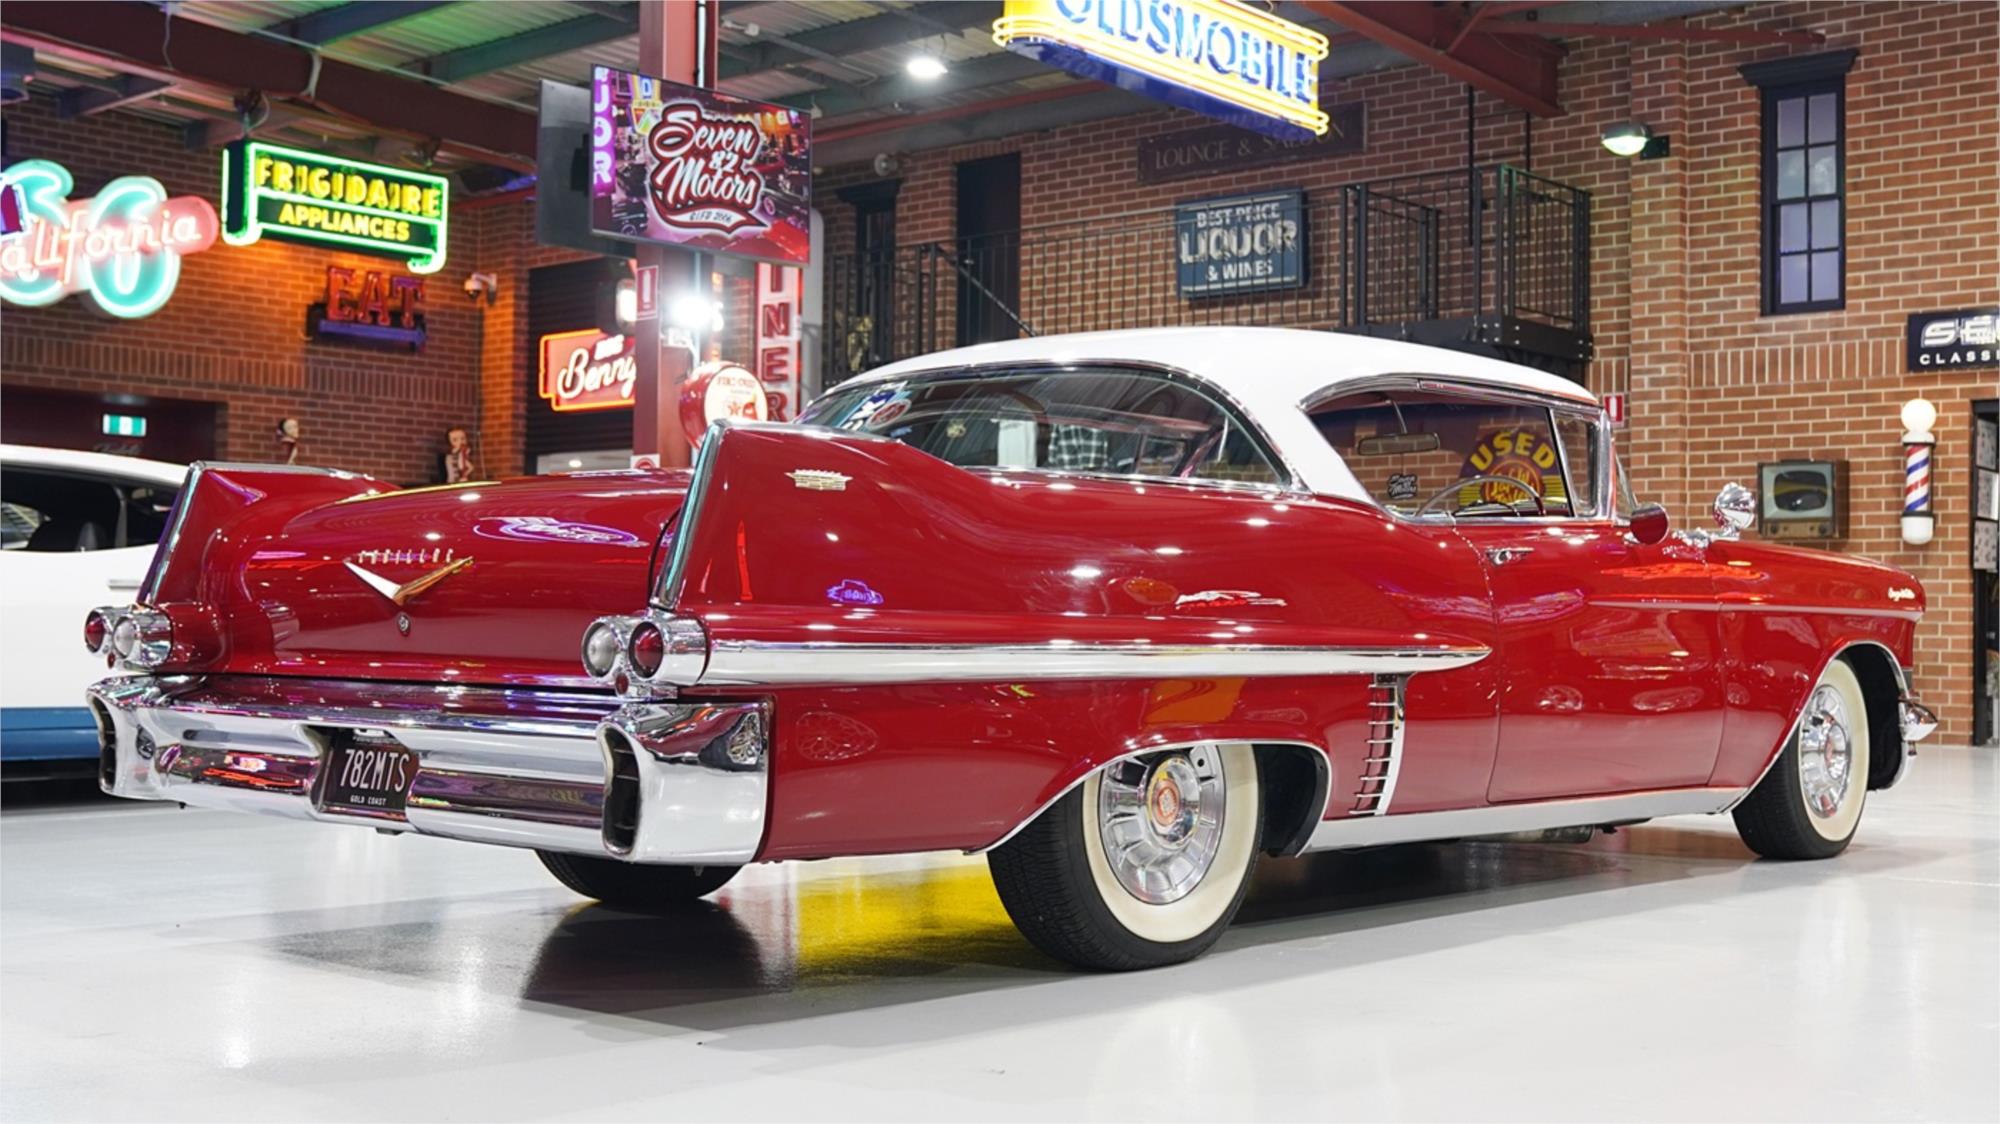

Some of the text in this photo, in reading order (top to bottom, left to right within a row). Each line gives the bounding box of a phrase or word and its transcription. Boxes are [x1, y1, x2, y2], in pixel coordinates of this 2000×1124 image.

[654, 110, 755, 158] Seven
[1155, 139, 1230, 169] LOUNGE
[1237, 139, 1252, 156] &
[256, 157, 441, 216] FRIGIDAIRE
[655, 157, 757, 205] Motors
[279, 204, 409, 242] APPLIANCES
[1197, 203, 1279, 228] BEST PRICE
[0, 208, 202, 285] alifornia
[1180, 220, 1297, 264] LIQUOR
[1207, 259, 1274, 280] & WINES
[328, 268, 424, 327] EAT
[760, 264, 792, 422] INER
[1470, 432, 1556, 471] USED
[340, 748, 409, 793] 782MTS
[350, 794, 386, 806] GOLD COAST
